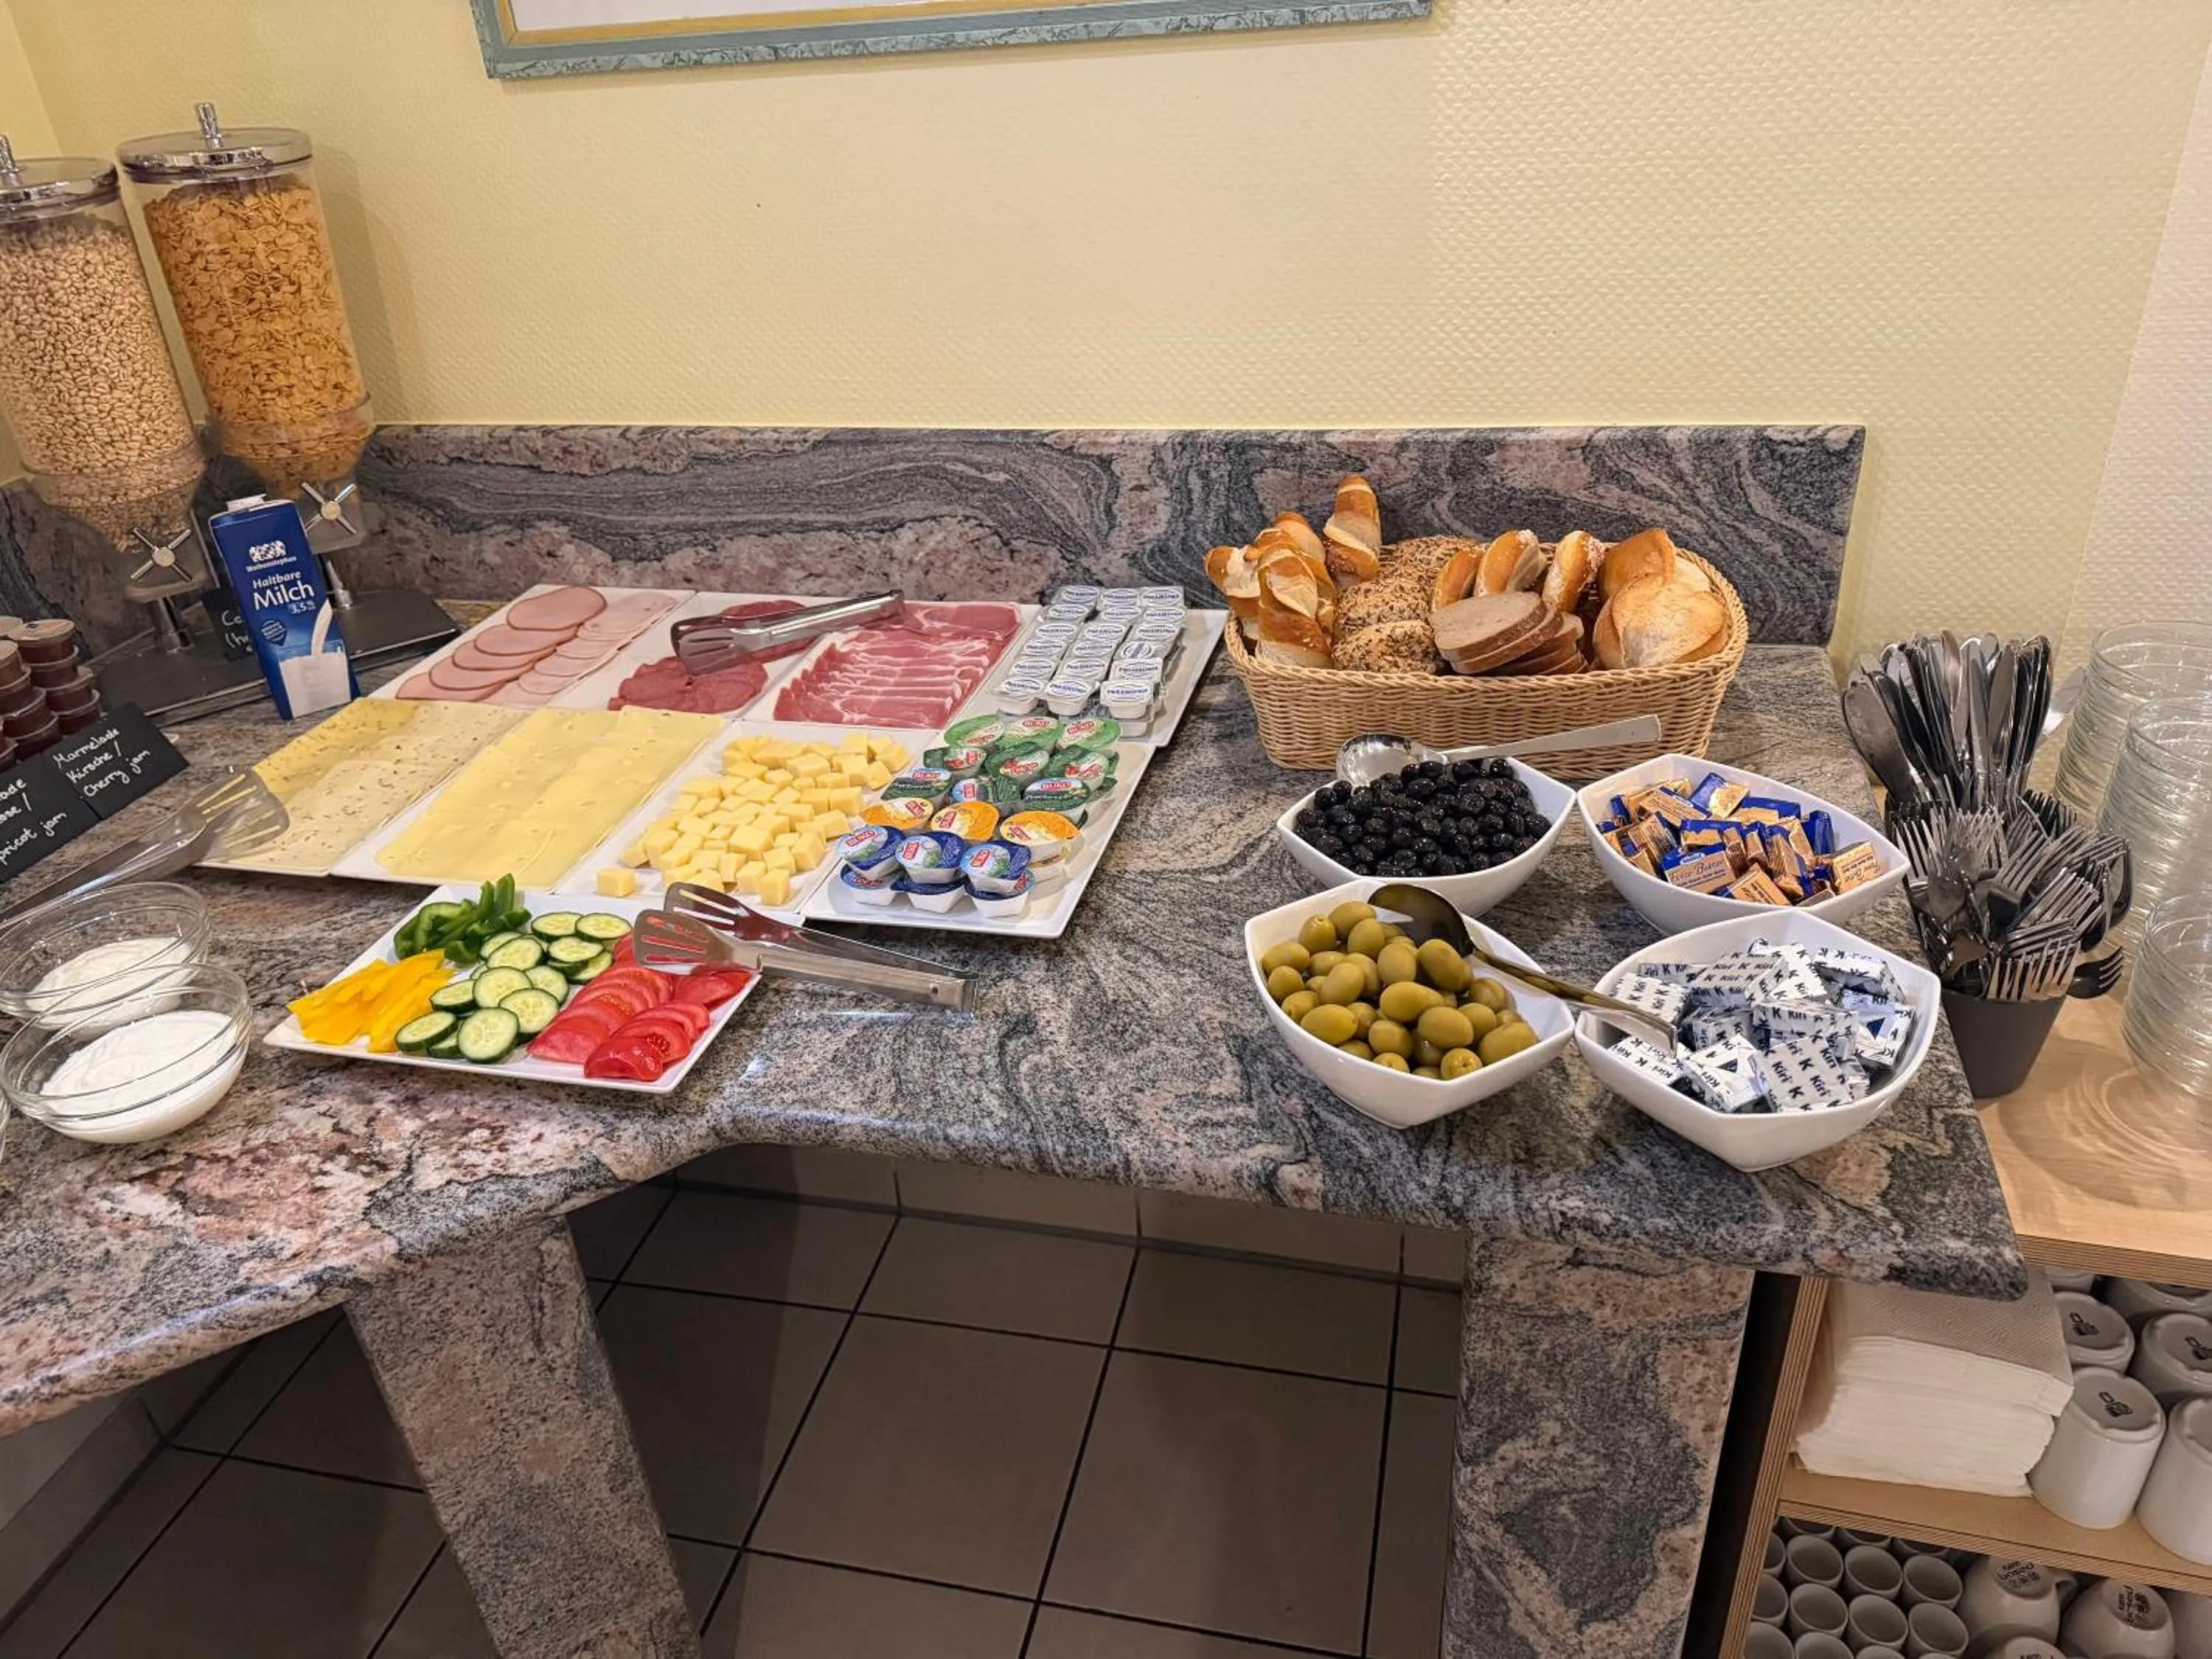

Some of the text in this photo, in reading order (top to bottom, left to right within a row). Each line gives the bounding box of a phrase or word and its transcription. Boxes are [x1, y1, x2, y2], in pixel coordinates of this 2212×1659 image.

[253, 571, 302, 589] Haltbare
[253, 580, 315, 611] Milch
[83, 749, 150, 797] Cherry jam
[40, 812, 67, 837] jam
[1772, 1006, 1782, 1020] K
[1635, 1057, 1649, 1067] K
[1819, 1048, 1837, 1069] Kiri
[1772, 1062, 1792, 1082] Kiri
[1788, 1086, 1804, 1099] K
[1799, 1058, 1815, 1071] K
[1810, 1075, 1829, 1096] Kiri
